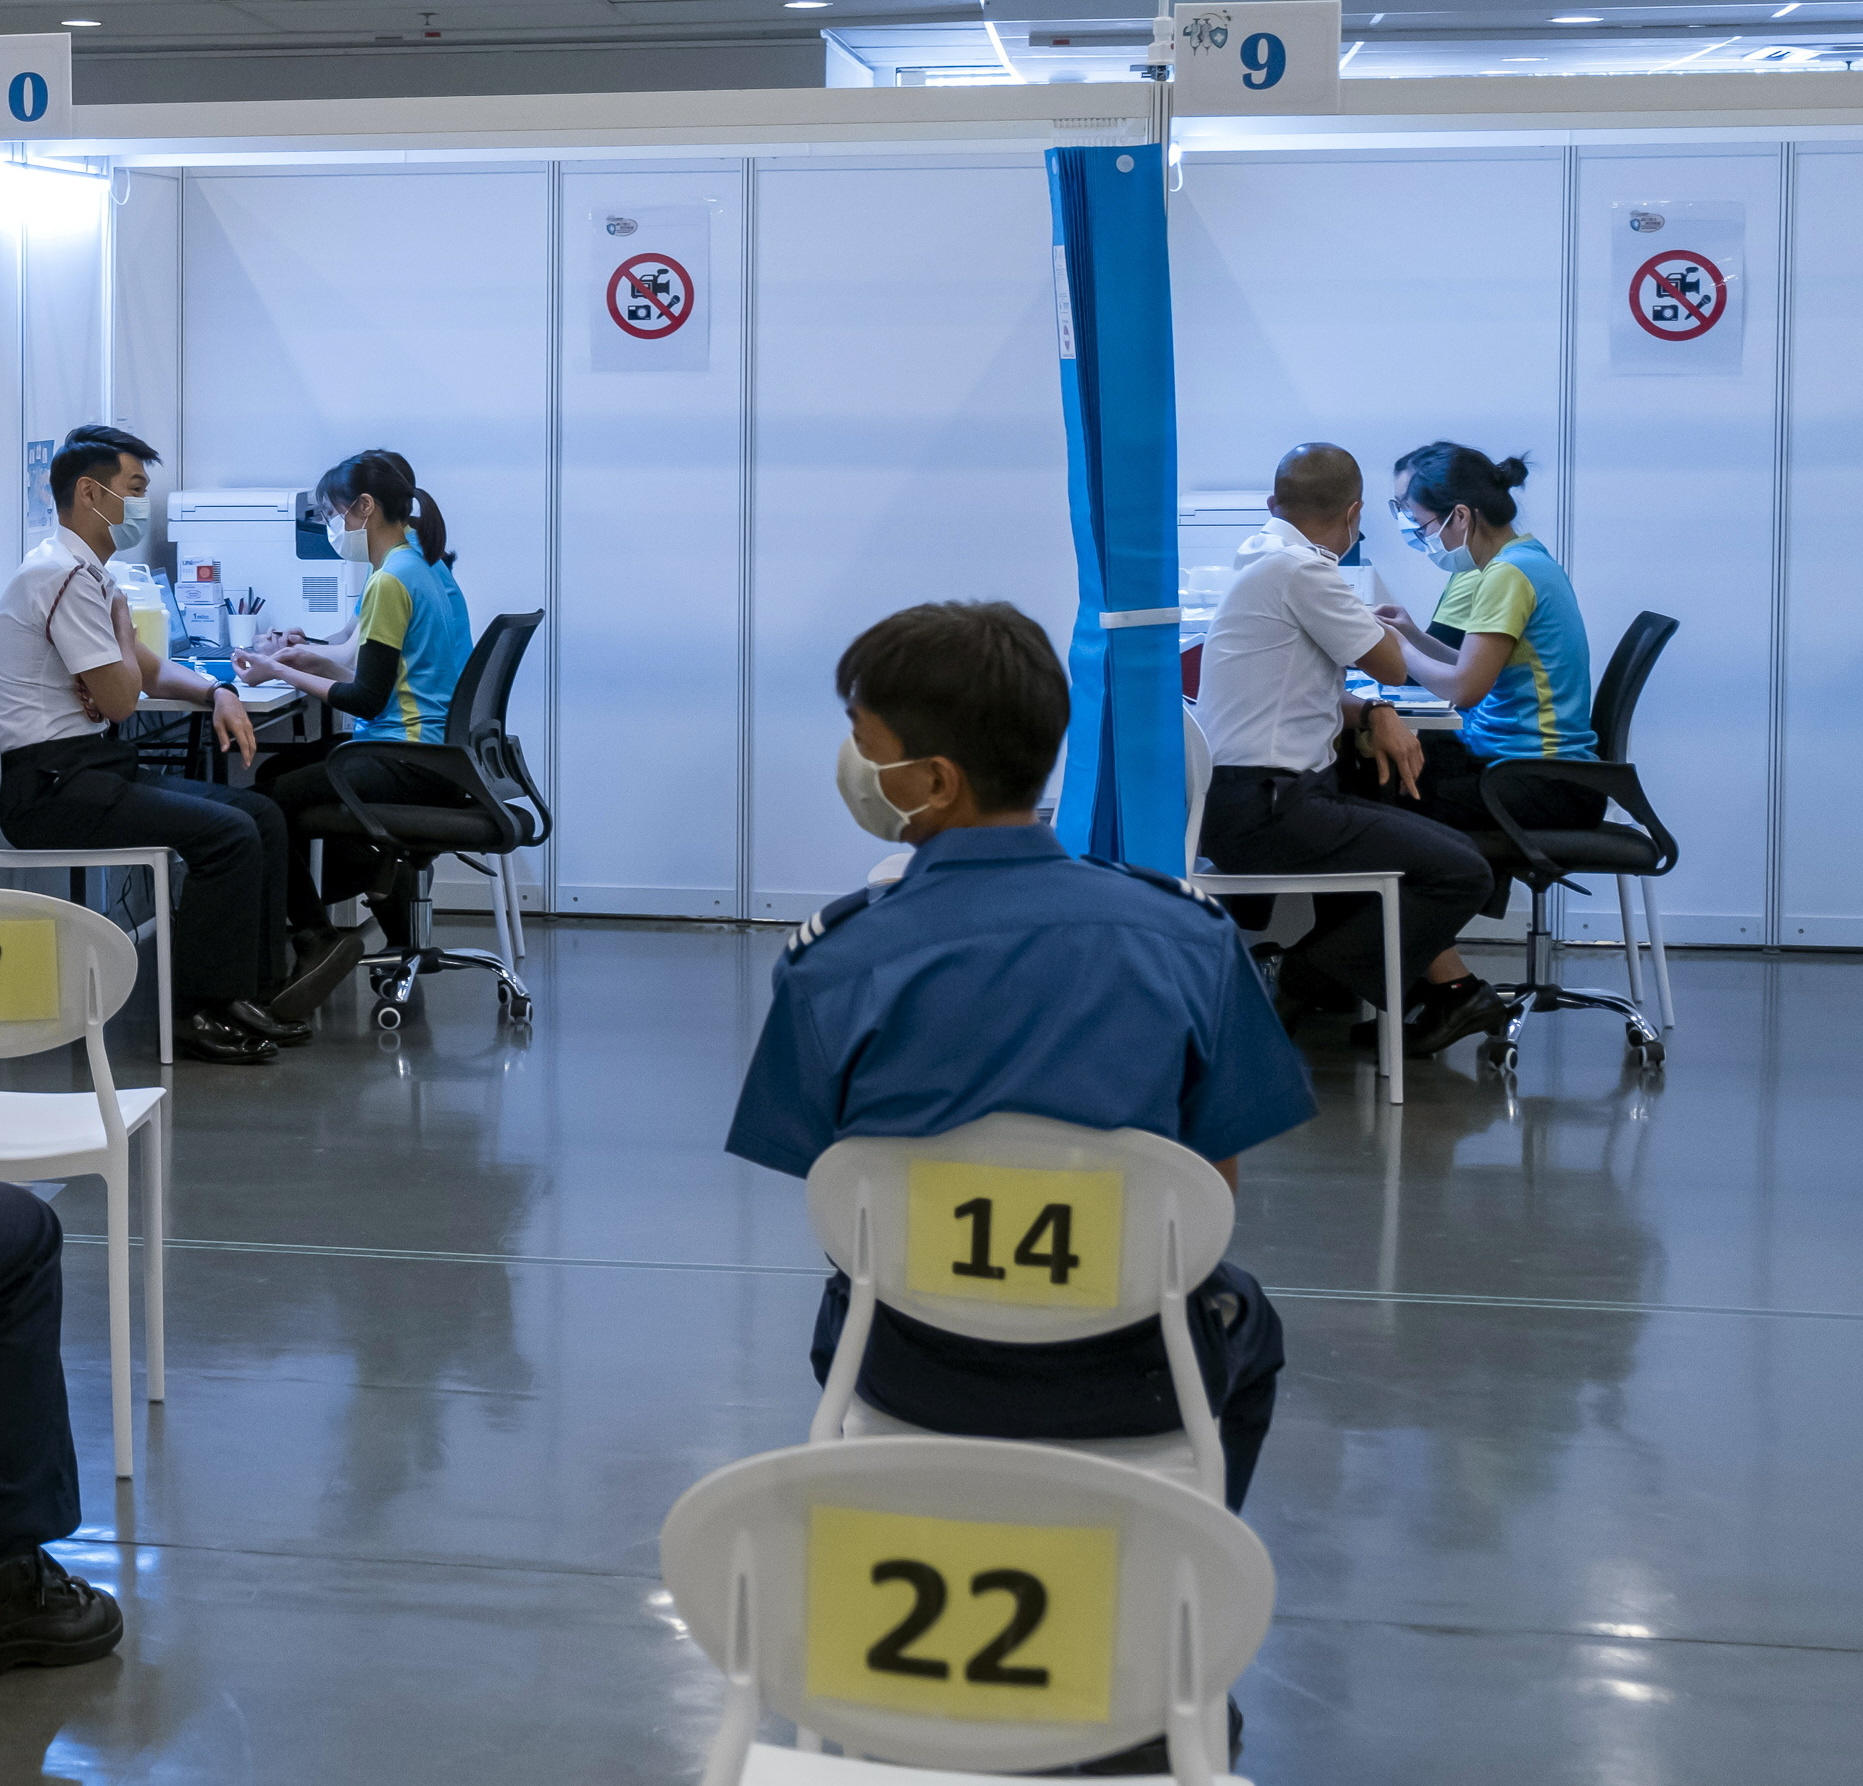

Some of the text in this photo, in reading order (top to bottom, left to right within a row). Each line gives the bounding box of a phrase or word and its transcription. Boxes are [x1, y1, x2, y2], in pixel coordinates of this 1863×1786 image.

[1240, 32, 1287, 91] 9
[951, 1197, 1081, 1286] 14
[865, 1557, 1051, 1689] 22
